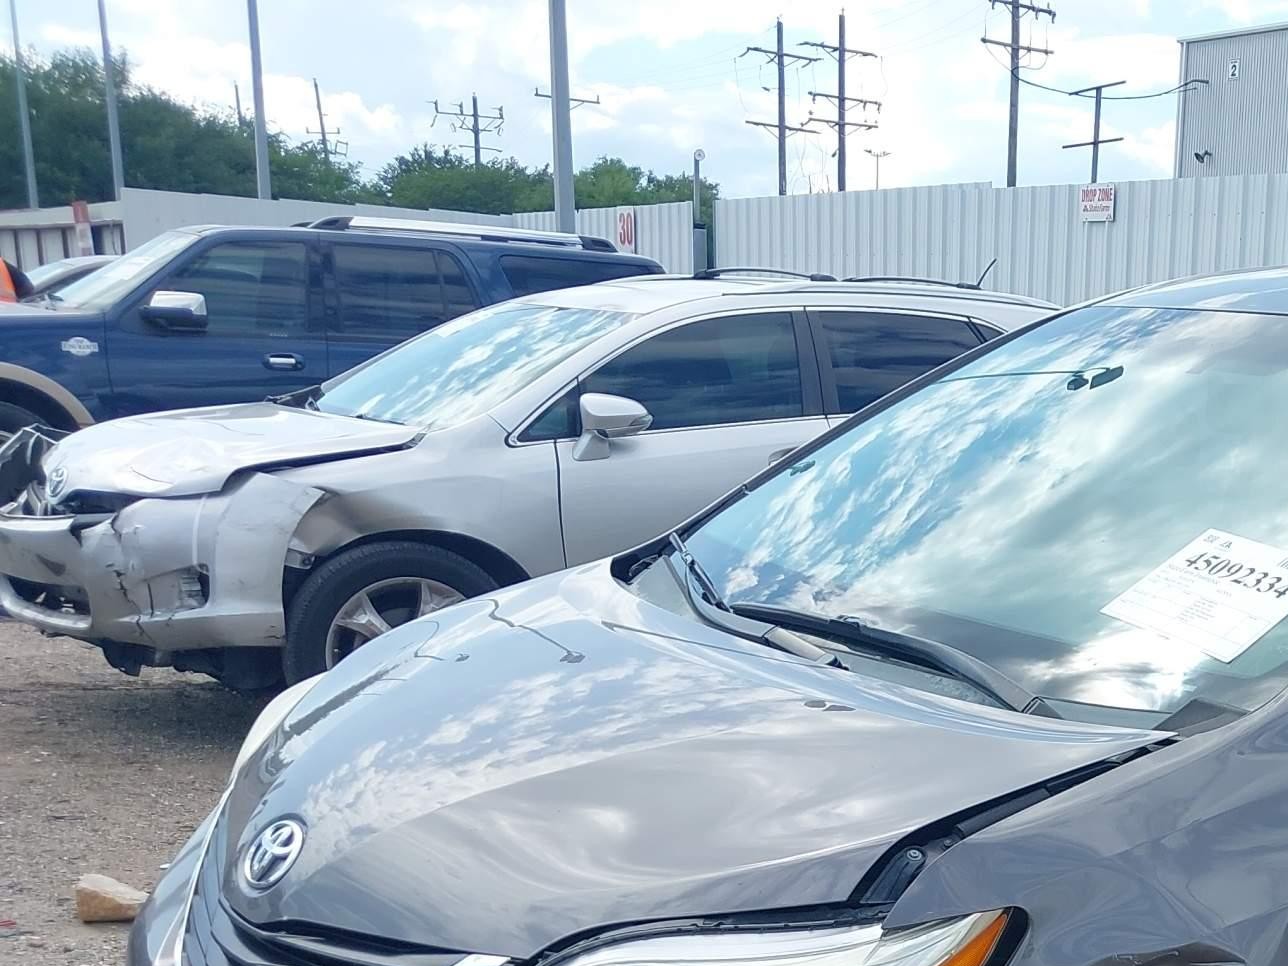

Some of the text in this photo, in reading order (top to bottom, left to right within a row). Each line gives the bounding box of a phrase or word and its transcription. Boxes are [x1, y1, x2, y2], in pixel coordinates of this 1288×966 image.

[1230, 64, 1237, 76] 2
[1081, 187, 1112, 202] DROP ZONE
[618, 212, 633, 246] 30
